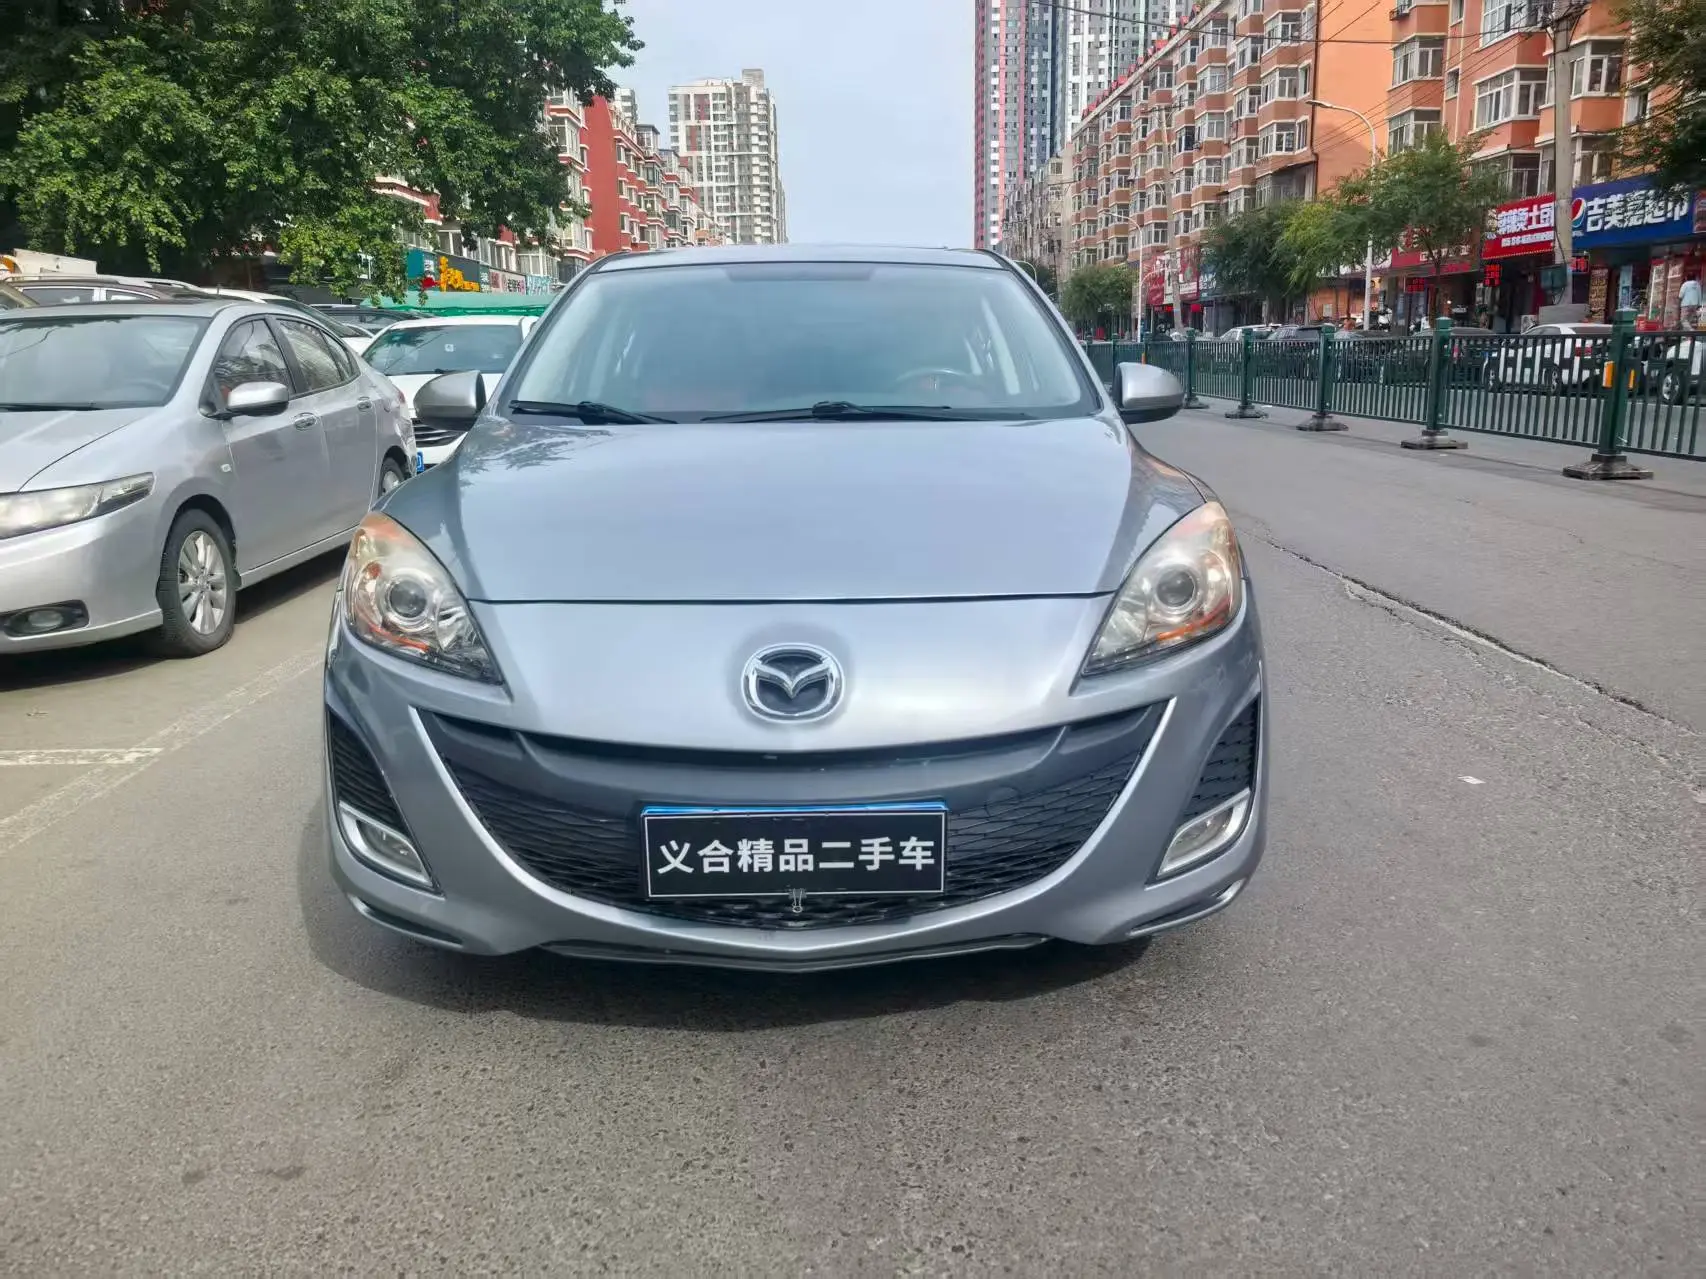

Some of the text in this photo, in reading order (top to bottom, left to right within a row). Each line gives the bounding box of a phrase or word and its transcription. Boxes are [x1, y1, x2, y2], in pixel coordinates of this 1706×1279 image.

[657, 836, 935, 874] 义合精品二手车
